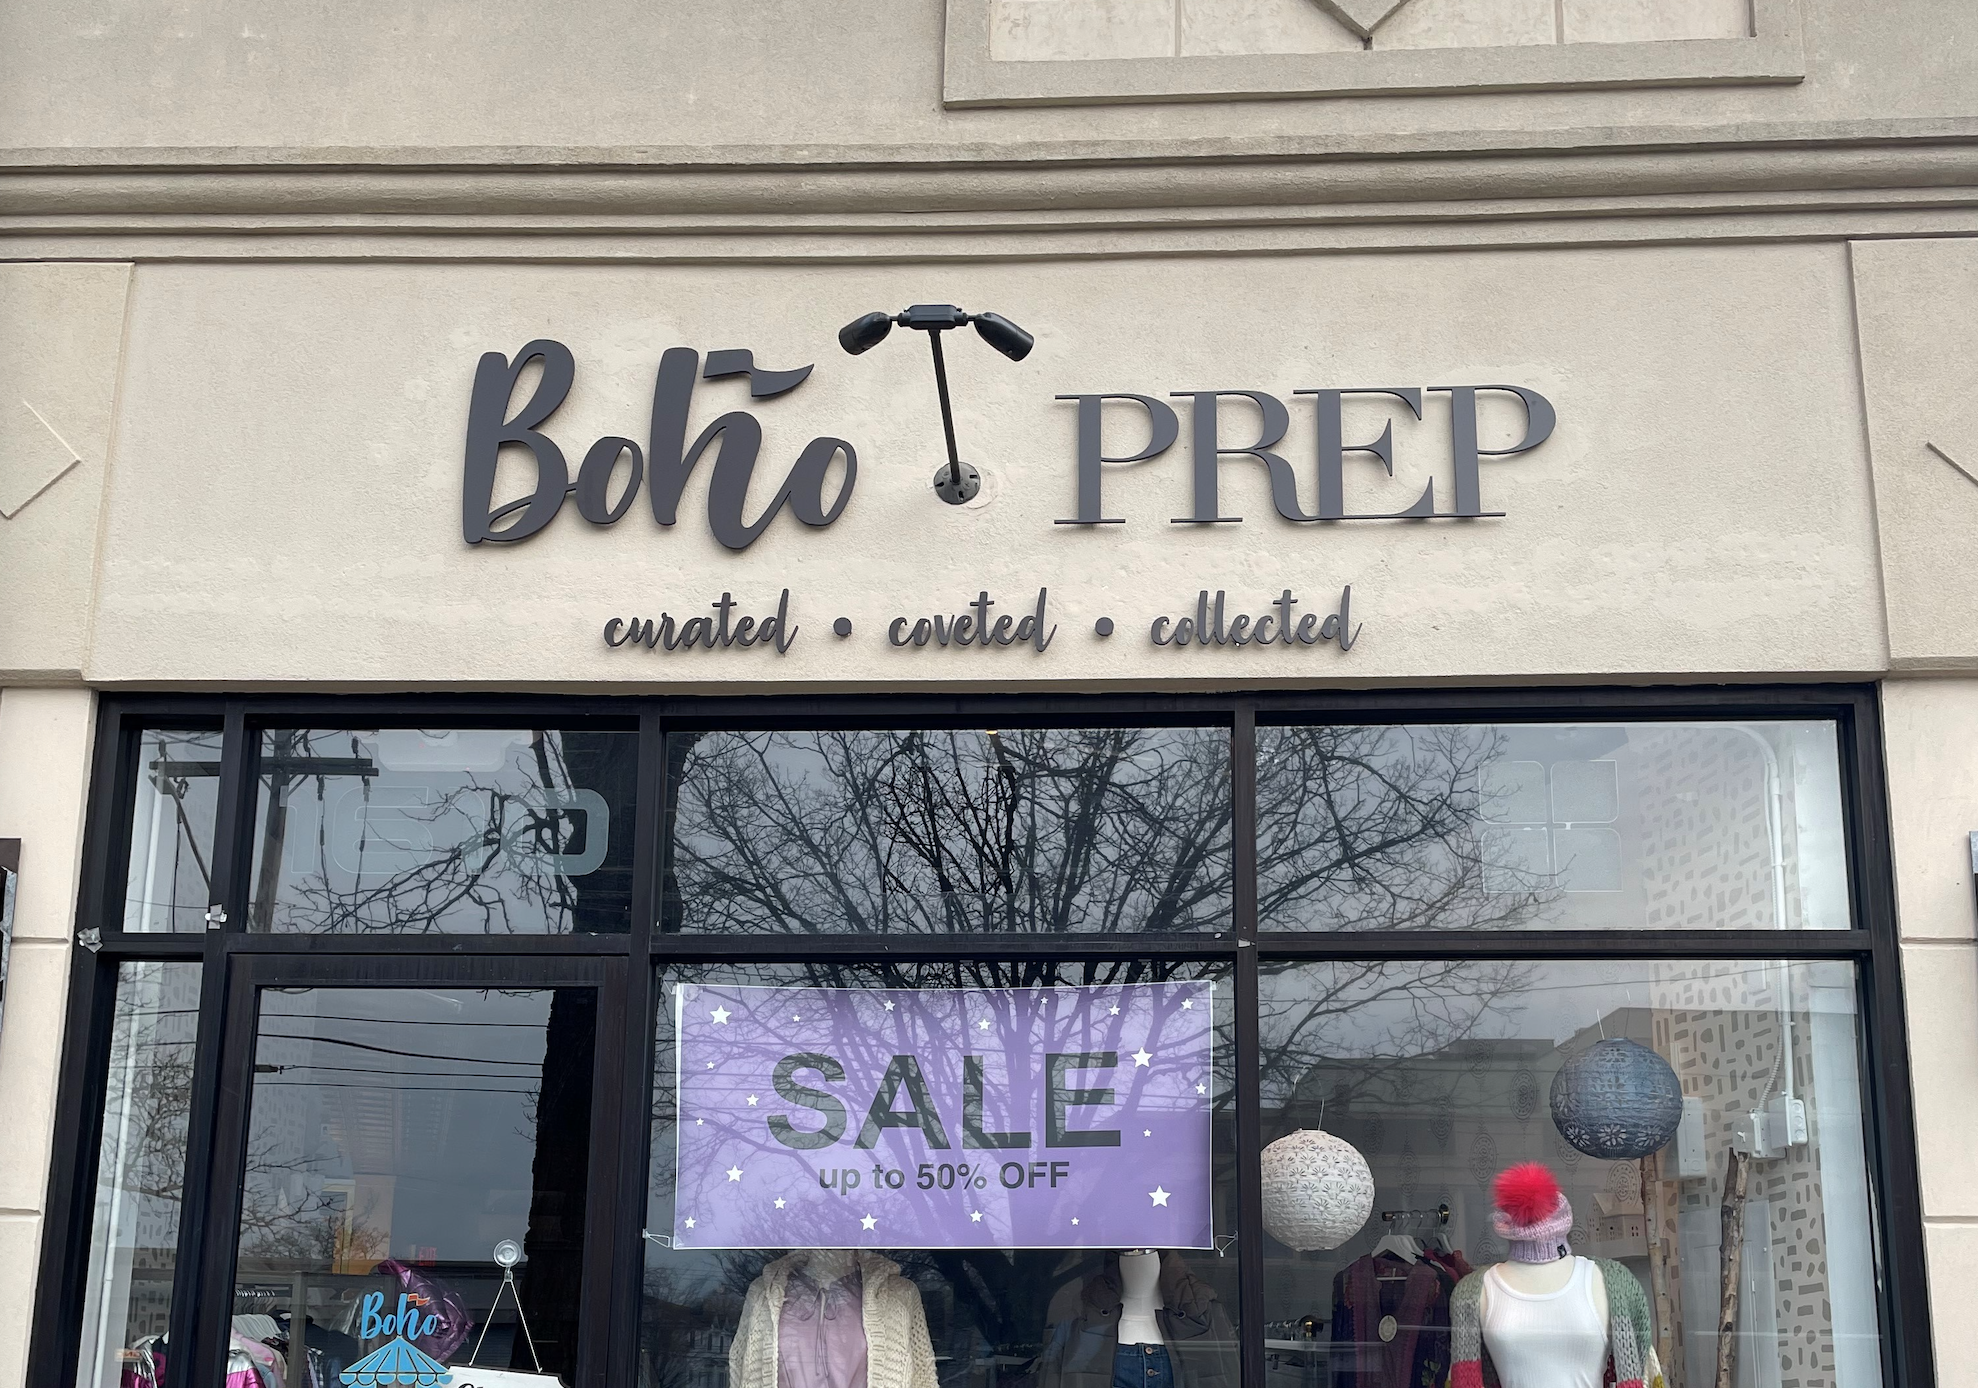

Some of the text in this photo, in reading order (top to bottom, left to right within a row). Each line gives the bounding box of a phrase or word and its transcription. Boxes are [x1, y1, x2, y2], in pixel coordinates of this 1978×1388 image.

[462, 339, 1557, 550] Boho PREP
[604, 585, 1363, 654] curated coveted collected
[766, 1051, 1122, 1150] SALE
[819, 1161, 1070, 1197] up to 50% OFF
[361, 1291, 438, 1341] Boho
